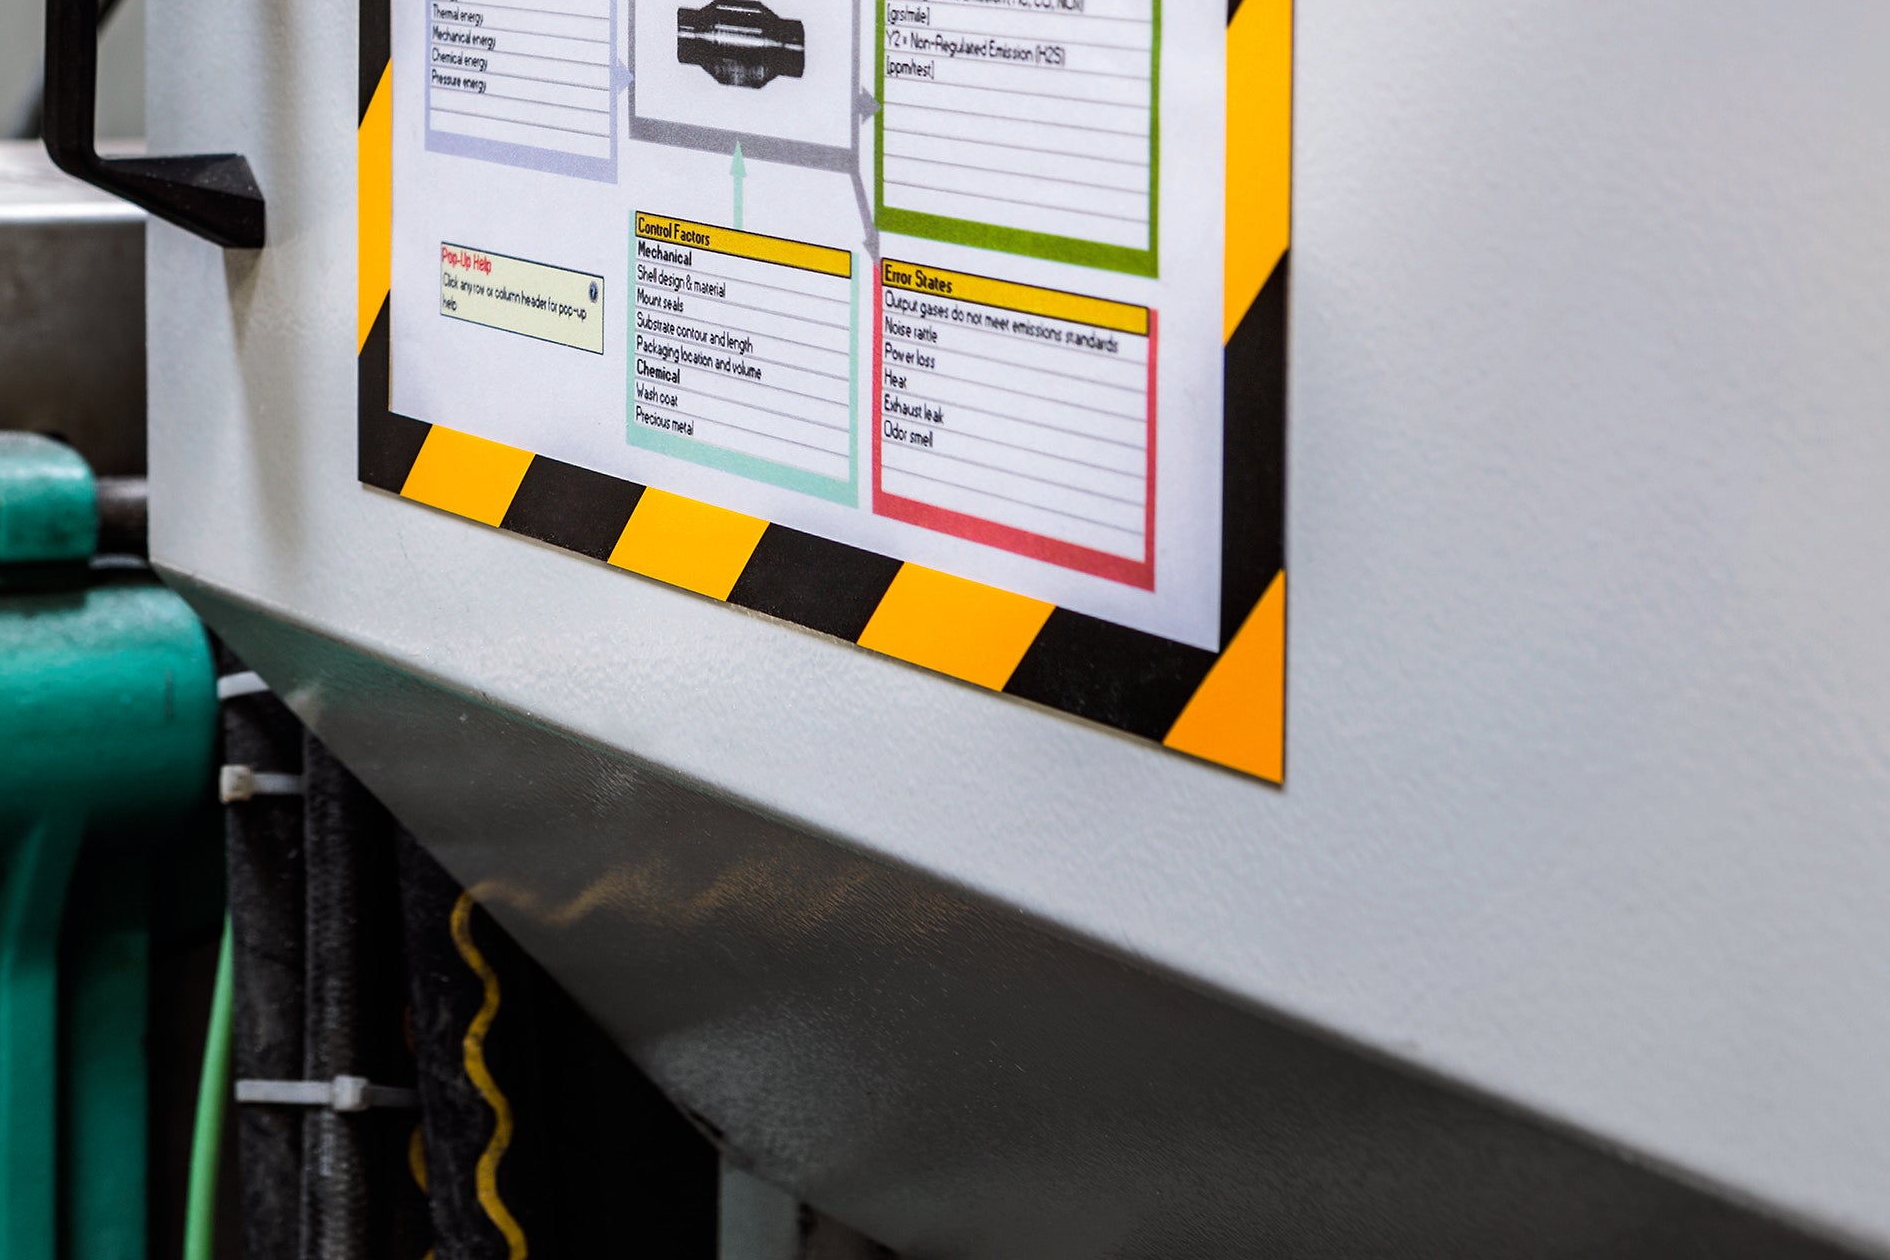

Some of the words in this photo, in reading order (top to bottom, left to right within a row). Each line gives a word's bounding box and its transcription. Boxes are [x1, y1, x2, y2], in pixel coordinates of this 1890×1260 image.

[638, 217, 671, 239] Control
[674, 225, 710, 246] Factors
[638, 241, 692, 266] Mechanical
[638, 264, 657, 282] Shell
[659, 269, 684, 291] design
[694, 278, 726, 298] material
[885, 265, 912, 284] Error
[916, 270, 952, 293] States
[559, 304, 586, 321] pop-up
[637, 289, 662, 307] Mount
[663, 297, 684, 312] seals
[885, 290, 918, 312] Output
[920, 298, 948, 318] gases
[951, 304, 964, 321] do
[967, 309, 982, 325] not
[985, 314, 1009, 330] meet
[1012, 320, 1062, 340] emissions
[637, 312, 675, 333] Substrate
[677, 325, 708, 341] contour
[710, 331, 725, 347] and
[727, 333, 753, 355] length
[885, 317, 911, 336] Noise
[915, 325, 937, 343] rattle
[637, 335, 679, 363] Packaging
[681, 346, 713, 368] location
[715, 355, 730, 372] and
[732, 362, 761, 379] volume
[885, 343, 915, 361] Power
[917, 348, 935, 368] loss
[637, 359, 680, 383] Chemical
[885, 369, 907, 388] Heat
[637, 383, 658, 402] Wash
[660, 393, 678, 406] coat
[636, 406, 670, 429] Precious
[672, 418, 694, 436] metal
[885, 394, 922, 416] Exhaust
[924, 403, 944, 424] leak
[884, 420, 907, 441] Odor
[910, 431, 933, 447] smell
